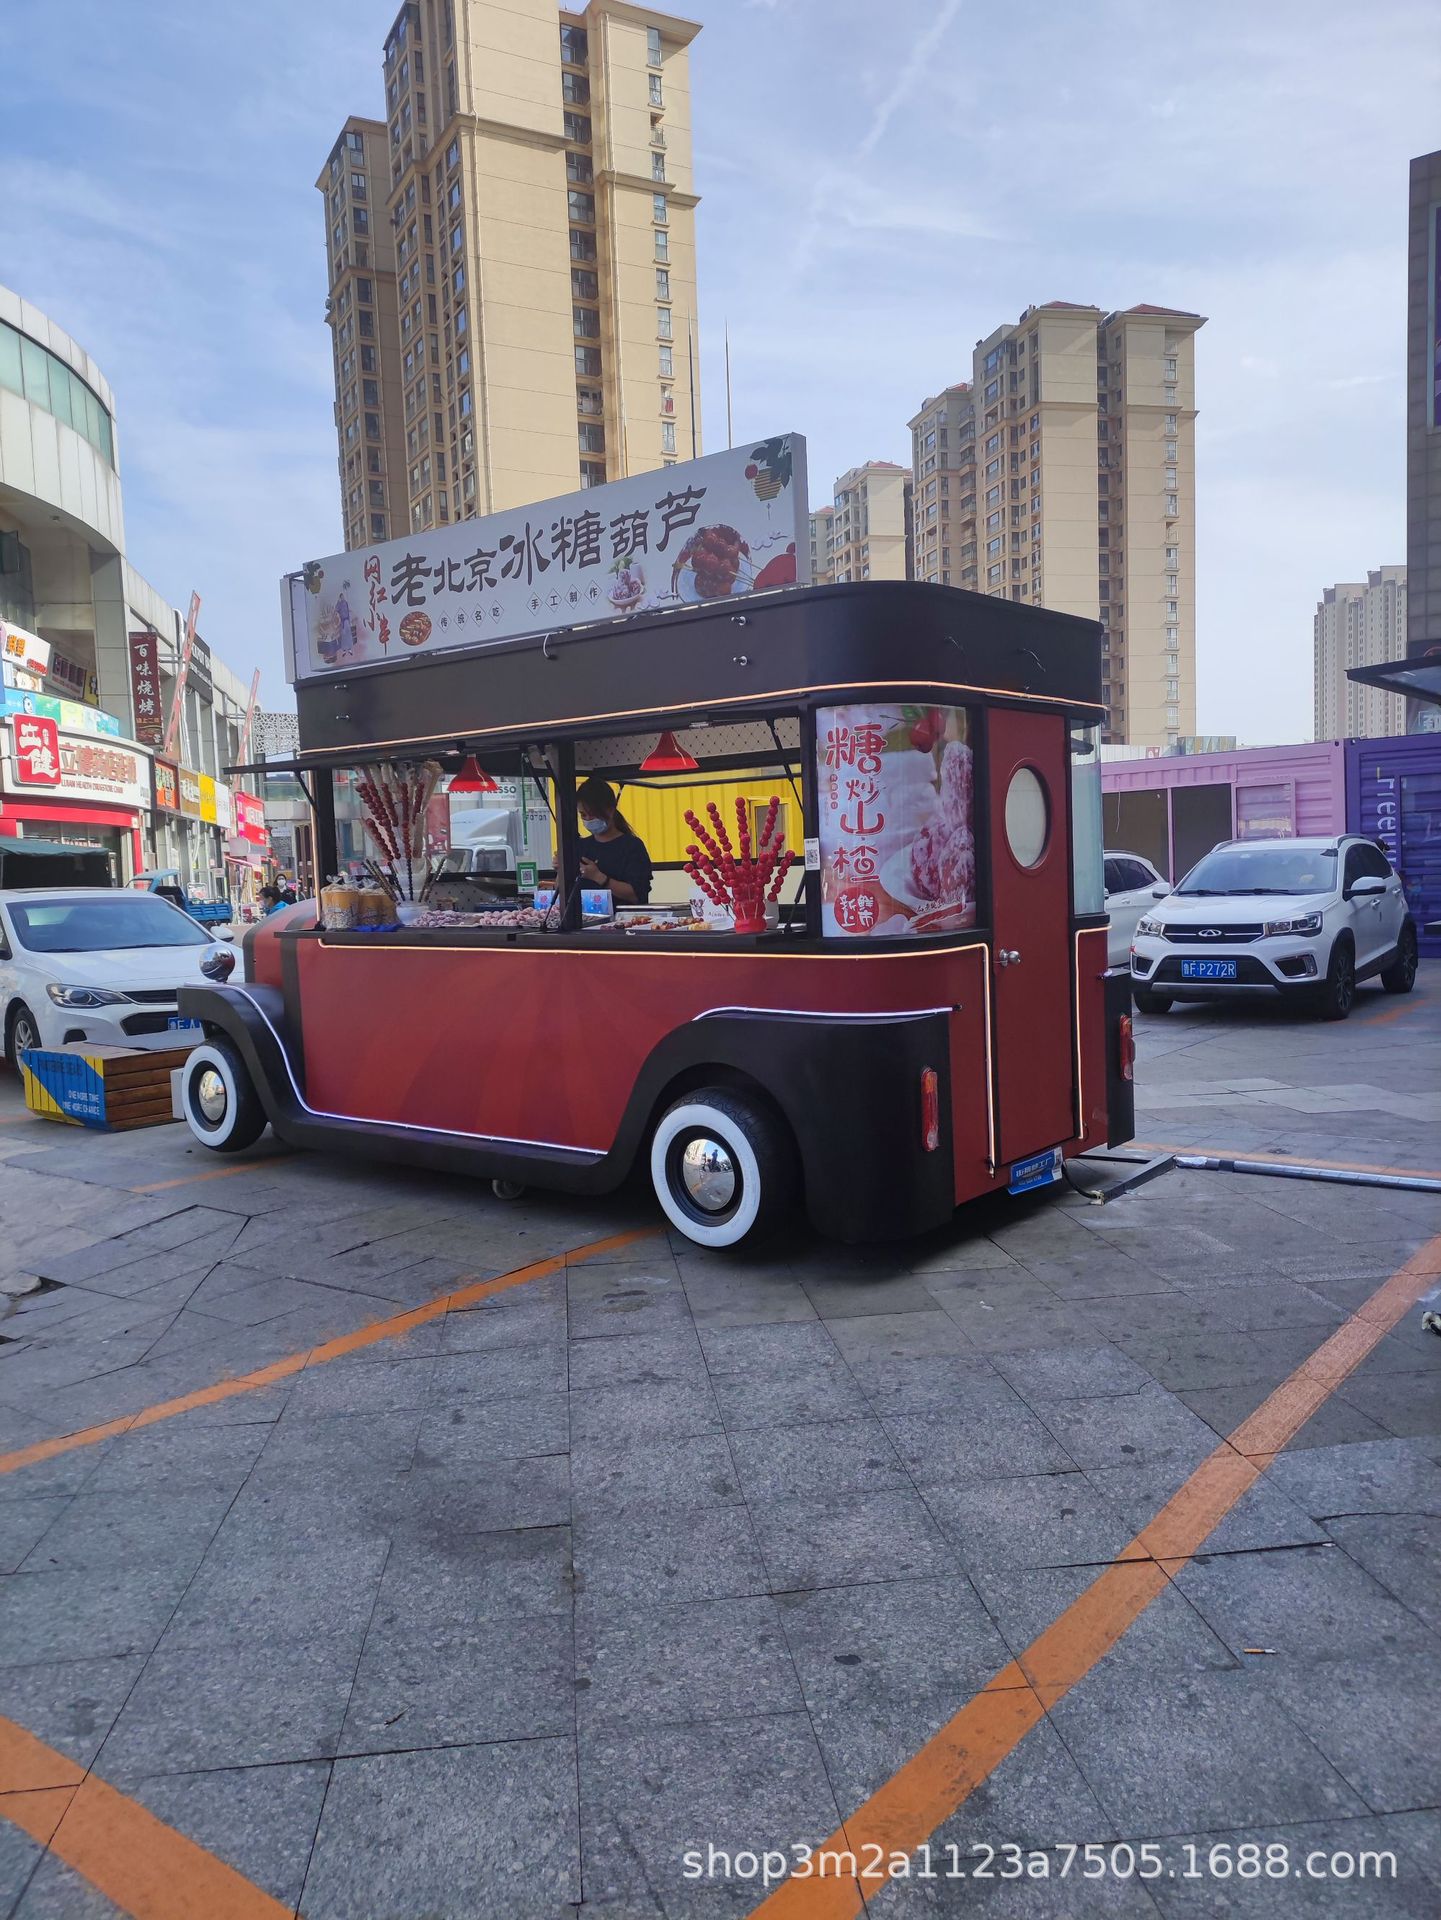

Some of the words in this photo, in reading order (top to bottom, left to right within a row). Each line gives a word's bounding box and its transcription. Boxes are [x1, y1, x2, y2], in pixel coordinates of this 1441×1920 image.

[391, 485, 707, 606] 老北京冰糖葫芦
[440, 607, 500, 628] 传统名吃
[531, 587, 598, 610] 手工制作
[134, 643, 155, 716] 百味烧烤
[826, 722, 888, 883] 糖炒山楂
